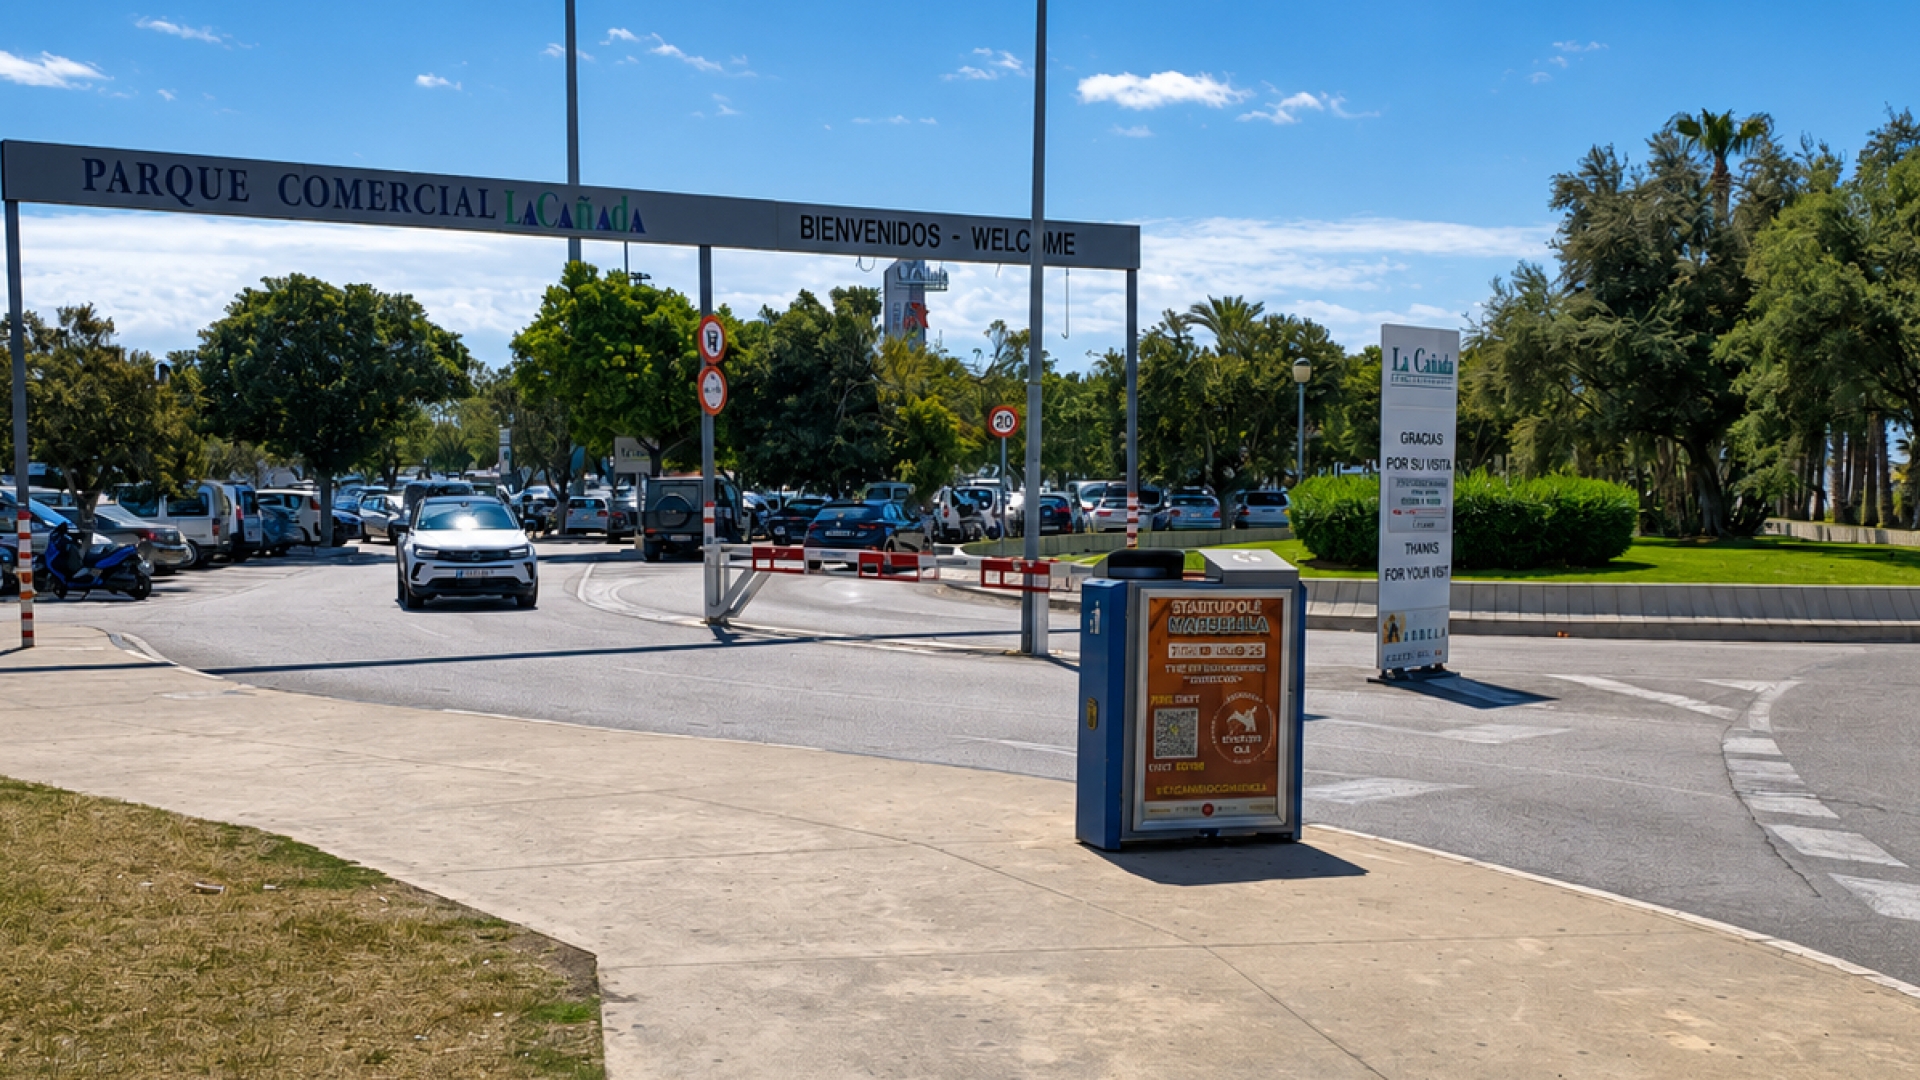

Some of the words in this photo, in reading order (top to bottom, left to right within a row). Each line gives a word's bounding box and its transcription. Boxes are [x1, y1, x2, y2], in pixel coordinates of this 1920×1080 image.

[82, 157, 249, 207] PARQUE
[277, 172, 496, 219] COMERCIAL
[800, 214, 941, 248] BIENVENIDOS
[971, 225, 1075, 256] WELCME
[996, 415, 1012, 428] 20
[1386, 457, 1409, 471] POR
[1410, 458, 1425, 471] SU
[1384, 567, 1405, 581] FOR
[1406, 566, 1430, 580] YOUR
